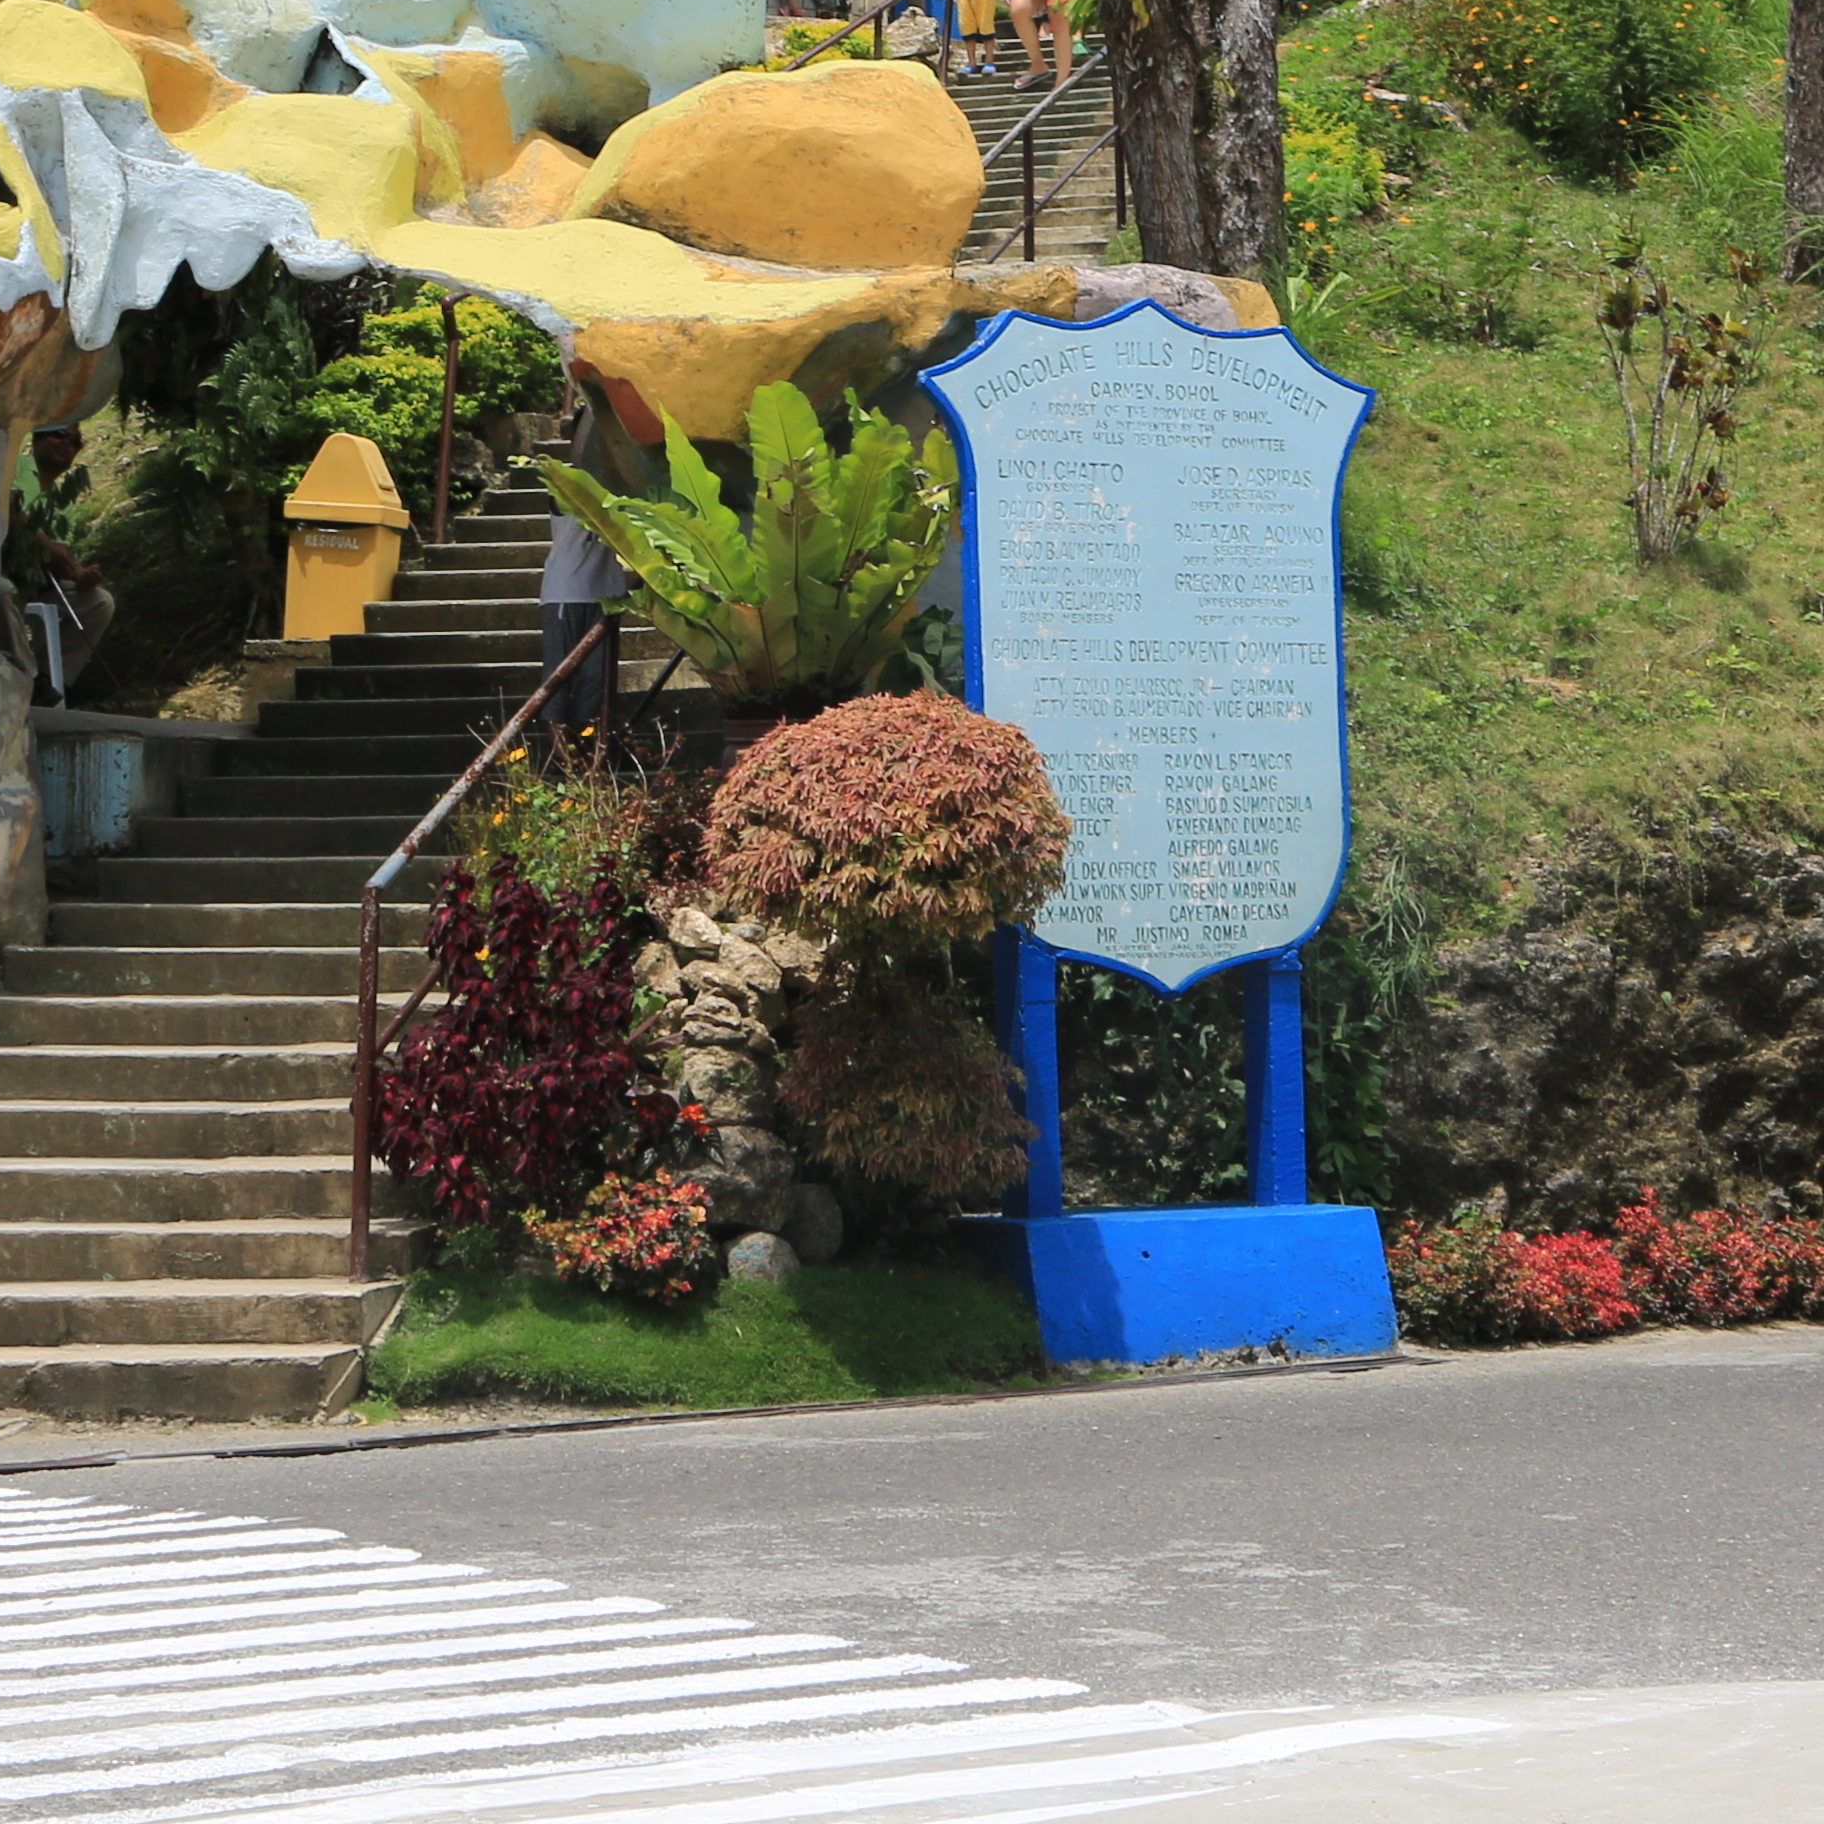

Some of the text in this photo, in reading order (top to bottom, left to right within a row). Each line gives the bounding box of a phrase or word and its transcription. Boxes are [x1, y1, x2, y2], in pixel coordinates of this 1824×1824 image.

[974, 341, 1329, 423] CHOCOLATE HILLS DEVELOPMENT
[1165, 383, 1220, 403] BOHOL
[1048, 402, 1097, 417] PROJECT
[1104, 404, 1121, 418] OF
[1124, 404, 1148, 419] THE
[1153, 406, 1207, 422] PROVINCE
[1213, 409, 1228, 423] OF
[1232, 410, 1273, 425] BOHOL
[1015, 428, 1286, 453] CHOCOLATE HILLS DEVELOPMENT COMMITTEE
[997, 459, 1036, 480] LINO
[1053, 460, 1124, 484] CHATTO
[1177, 466, 1313, 489] JOSE D. ASPIRAS
[1027, 482, 1094, 494] GOVERNOR
[1211, 488, 1279, 501] SECRETARY
[998, 499, 1126, 522] DAVID B. TIROL
[1227, 502, 1240, 513] OF
[1247, 502, 1296, 515] TOURISM
[303, 533, 360, 550] RESIDUAL
[1174, 522, 1324, 545] BALTAZAR AQUINO
[999, 539, 1043, 561] ERICO
[1213, 545, 1281, 557] SECRETARY
[1174, 573, 1247, 594] GREGORIO
[1252, 574, 1316, 595] ARANETA
[1001, 590, 1036, 610] JUAN
[1198, 596, 1291, 609] UNDERSECRETARY
[1020, 612, 1115, 625] BOARD MEMBERS
[1231, 615, 1246, 627] OF
[991, 638, 1329, 665] CHOCOLATE HILLS DEVELOPMENT COMMITTEE
[1230, 679, 1296, 697] CHAIRMAN
[1073, 699, 1108, 718] ERICO
[1246, 701, 1314, 720] CHAIRMAN
[1129, 726, 1199, 745] MEMBERS
[1074, 753, 1140, 773] TREASURER
[1163, 753, 1213, 772] RAMON
[1164, 775, 1279, 794] RAMON GALANG
[1080, 796, 1120, 816] ENGR.
[1166, 797, 1218, 815] BASILIO
[1166, 817, 1239, 836] VENERANDO
[1167, 838, 1280, 858] ALFREDO GALANG
[1109, 861, 1158, 880] OFFICER
[1167, 859, 1282, 879] ISMAEL VILLAMOR
[1129, 882, 1167, 902] SUPT.
[1168, 882, 1228, 900] VIRGENIO
[1169, 902, 1291, 924] CAYETANO DECASA
[1096, 924, 1249, 945] MR. JUSTINO ROMEA
